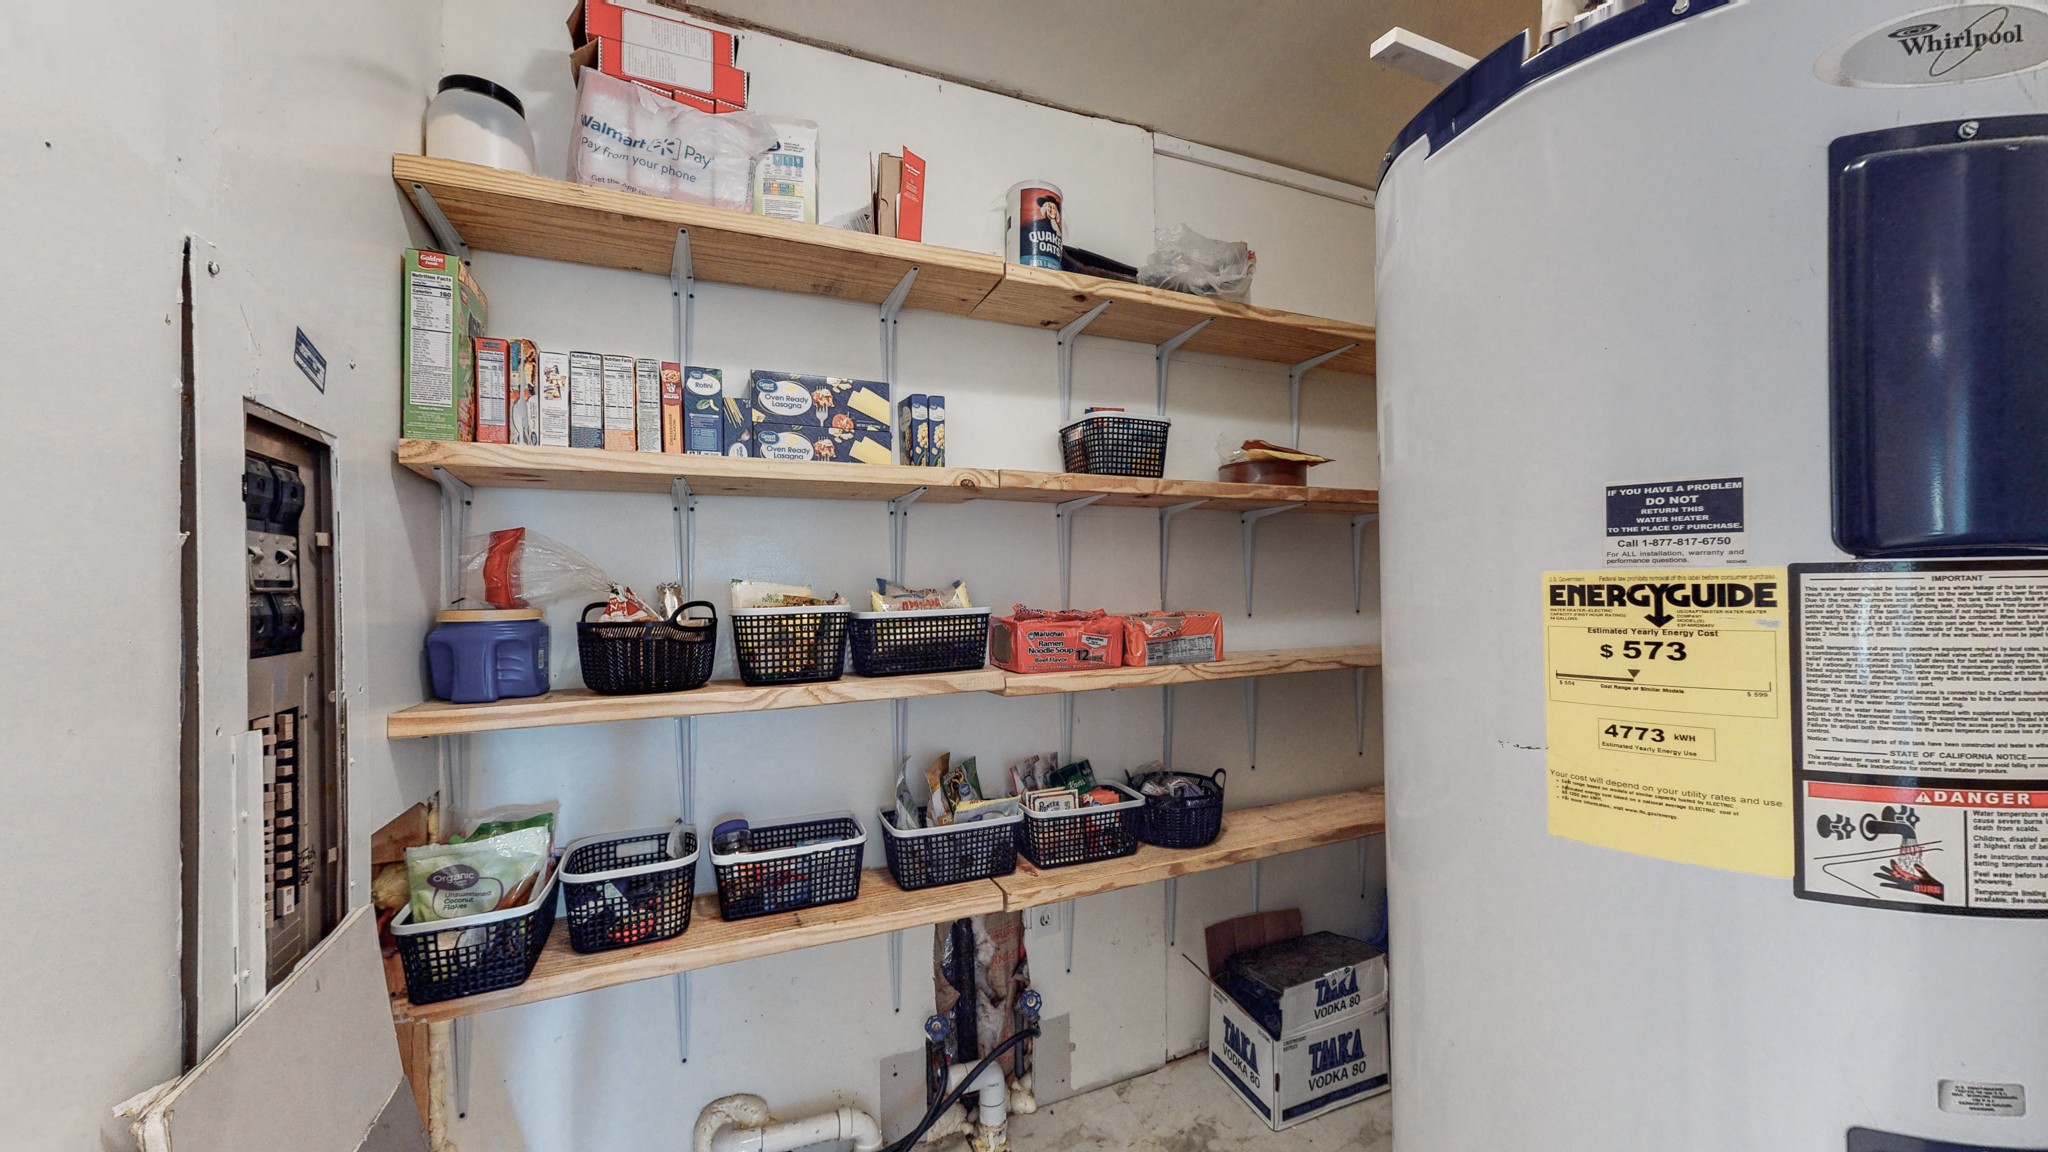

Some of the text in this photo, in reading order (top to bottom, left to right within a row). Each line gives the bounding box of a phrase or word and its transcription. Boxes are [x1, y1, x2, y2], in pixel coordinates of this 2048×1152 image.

[1898, 24, 2024, 56] Whirlpool
[581, 113, 710, 169] Walmart Pay
[581, 136, 697, 183] Pay from your phone
[591, 174, 605, 183] Get
[1029, 231, 1062, 248] QUAKE
[1039, 242, 1060, 257] OATS
[420, 254, 443, 263] Golden
[772, 401, 802, 409] Lasagna
[786, 396, 808, 404] Ready
[788, 447, 810, 455] Ready
[1620, 488, 1641, 496] YOU
[1644, 486, 1673, 494] HAVE
[1687, 482, 1742, 491] PROBLEM
[1646, 495, 1699, 505] DO NOT
[1687, 522, 1743, 530] PURCHASE.
[1618, 537, 1731, 547] Call 1-877-817-6750
[1606, 557, 1650, 565] performance
[1550, 583, 1778, 609] ENERGYGUIDE
[1588, 627, 1628, 635] Estimated
[1631, 628, 1659, 637] Yearly
[1662, 629, 1694, 638] Energy
[1076, 650, 1089, 660] 12
[1600, 640, 1687, 661] $ 573
[1604, 724, 1696, 743] 4773 kWH
[1602, 741, 1633, 749] Estimated
[1635, 745, 1656, 753] Yearly
[1658, 748, 1682, 757] Energy
[1939, 752, 1993, 760] CALIFORNIA
[1549, 769, 1568, 778] Your
[1570, 773, 1587, 781] cost
[1589, 775, 1603, 784] will
[1606, 779, 1639, 790] depend
[1657, 787, 1678, 795] your
[1681, 790, 1707, 800] utility
[1711, 793, 1736, 802] rates
[1934, 791, 2031, 804] DANGER
[433, 872, 474, 883] Organic
[445, 890, 491, 898] Unsweetened
[1314, 994, 1360, 1020] VODKA 80
[1222, 1043, 1260, 1089] VODKA 80
[1308, 1061, 1366, 1091] VODKA 80
